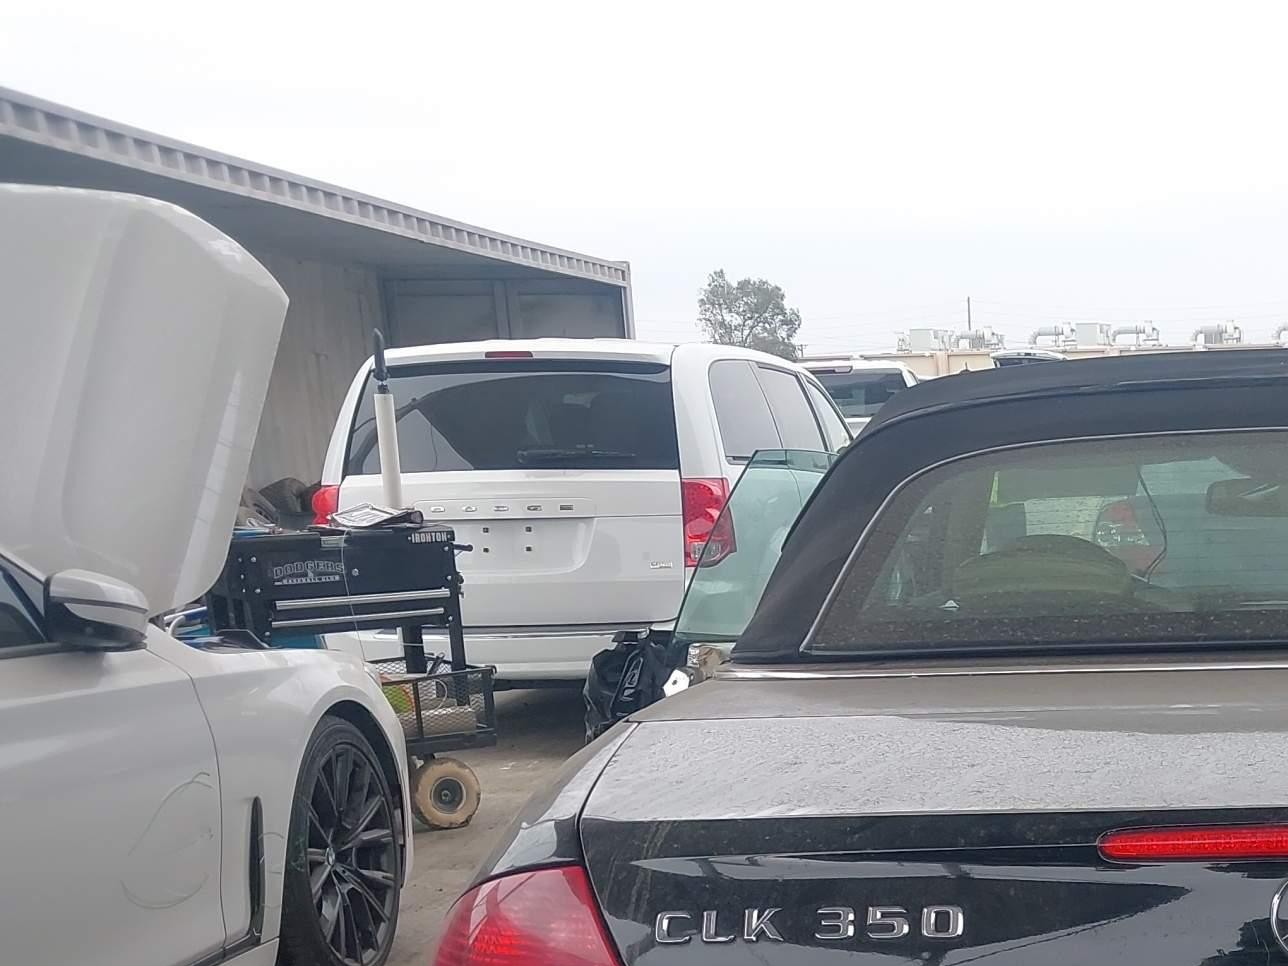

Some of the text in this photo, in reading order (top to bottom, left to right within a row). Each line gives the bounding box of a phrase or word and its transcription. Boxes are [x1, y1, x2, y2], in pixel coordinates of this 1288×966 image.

[273, 560, 344, 578] DODGERS
[655, 905, 965, 944] CLK 350
